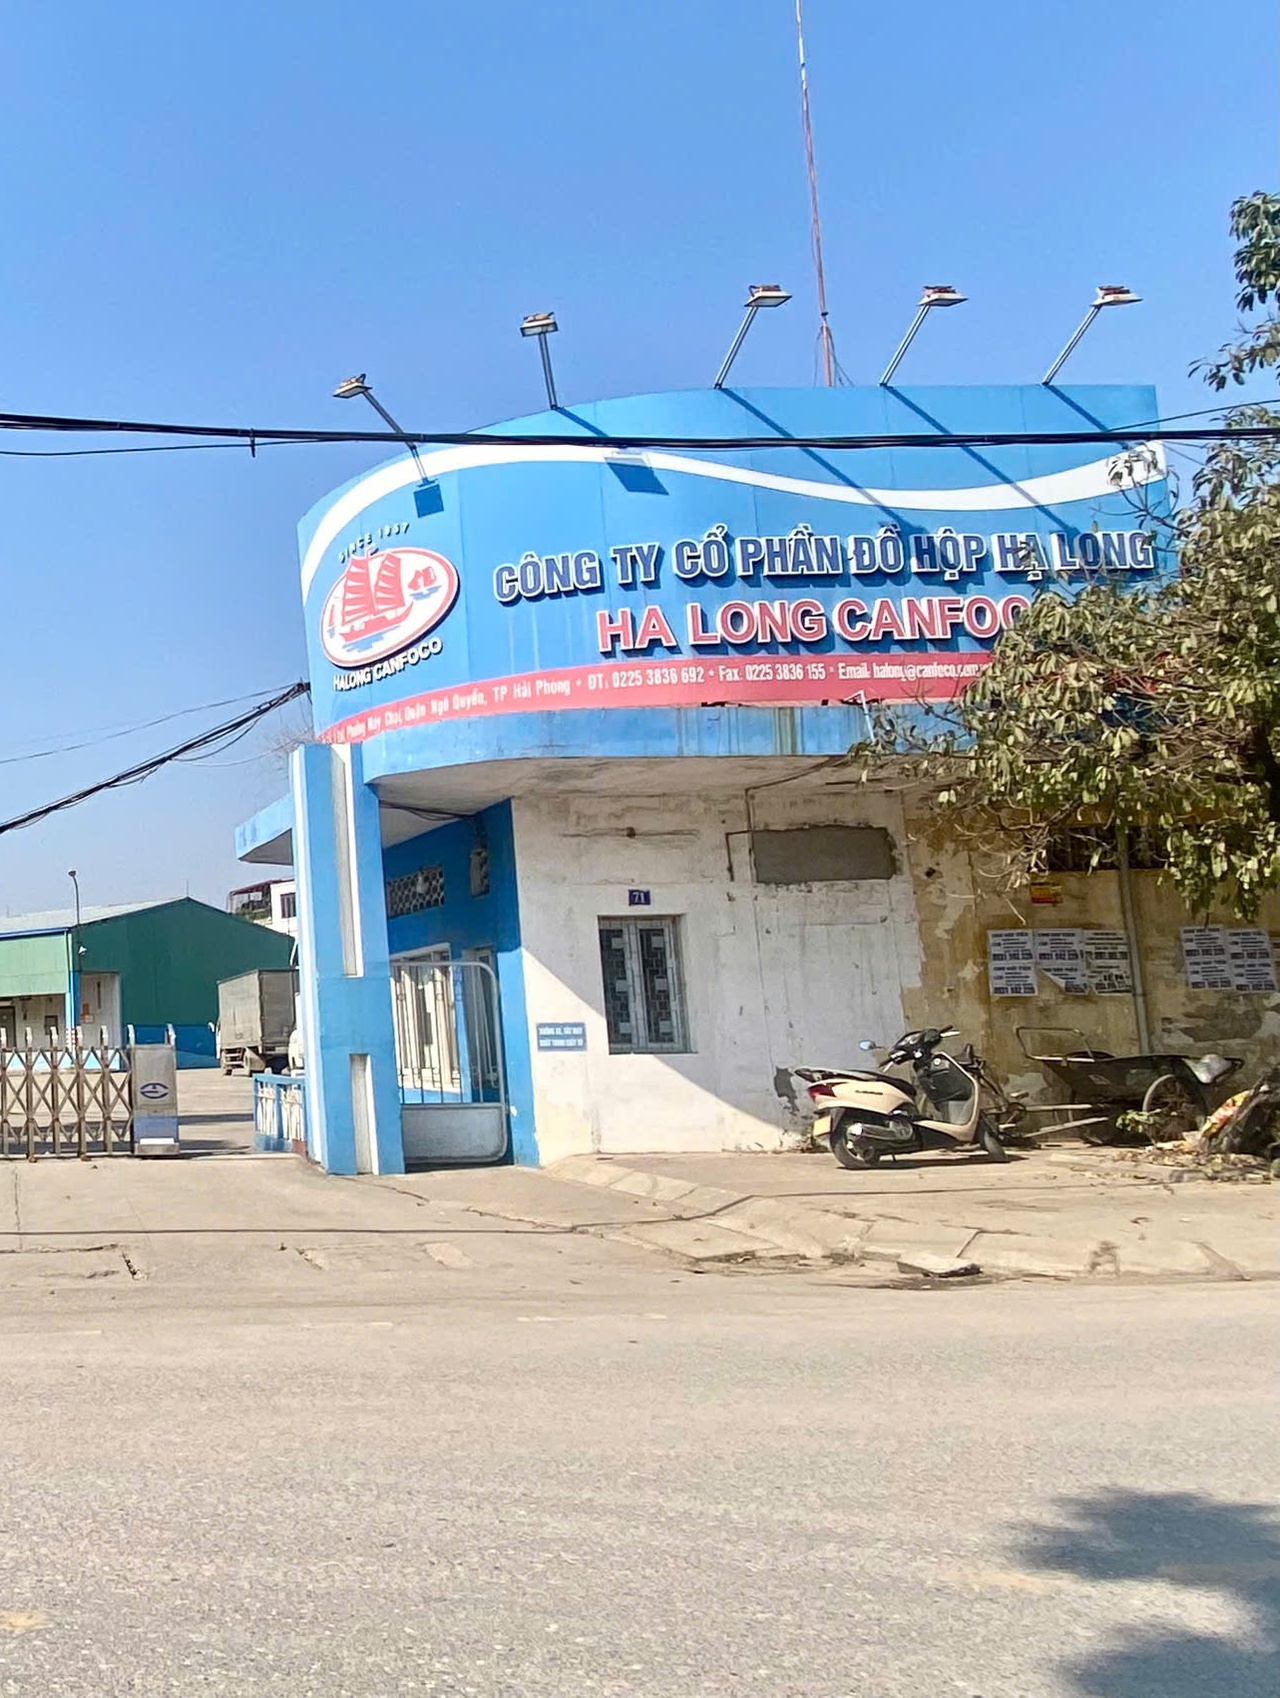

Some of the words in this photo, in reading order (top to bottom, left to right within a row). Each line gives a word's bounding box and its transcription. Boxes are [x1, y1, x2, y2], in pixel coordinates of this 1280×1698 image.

[493, 550, 601, 603] CÔNG
[610, 541, 660, 585] TY
[673, 522, 728, 580] CỔ
[735, 522, 843, 577] PHẦN
[848, 522, 905, 575] ĐỒ
[911, 526, 986, 581] HỘP
[991, 532, 1049, 581] HẠ
[1051, 530, 1154, 570] LONG
[596, 603, 677, 653] HA
[686, 599, 827, 645] LONG
[834, 595, 1031, 646] CANFOC
[333, 667, 373, 692] HALONG
[372, 637, 444, 680] CANFOCO
[492, 686, 508, 701] TP
[612, 669, 642, 688] 0225
[646, 667, 678, 685] 3836
[681, 665, 705, 683] 692
[745, 663, 773, 681] 0225
[775, 662, 803, 680] 3836
[806, 662, 826, 680] 155
